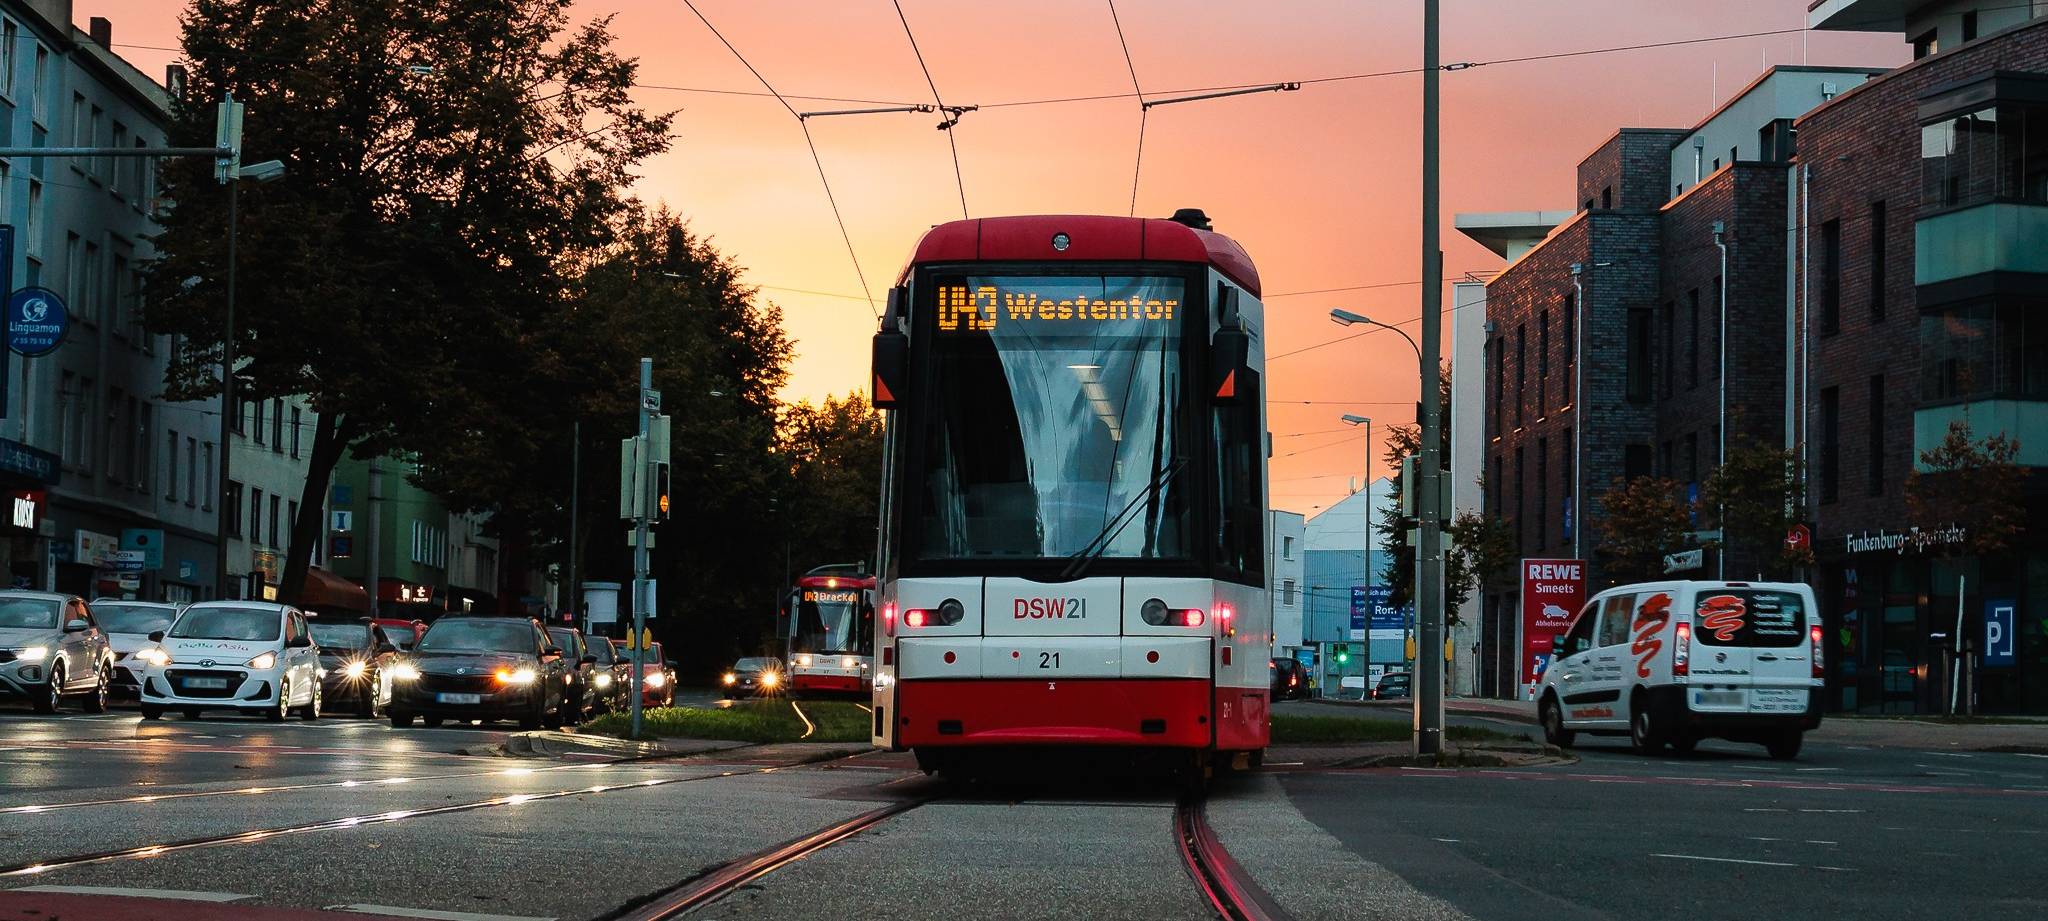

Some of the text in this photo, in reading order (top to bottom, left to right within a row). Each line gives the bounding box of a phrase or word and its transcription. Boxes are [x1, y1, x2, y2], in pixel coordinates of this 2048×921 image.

[938, 286, 1179, 331] U43 Westentor
[9, 321, 60, 334] Linguamon
[13, 497, 36, 528] KIOSK
[1528, 564, 1581, 580] REWE
[1535, 582, 1574, 594] Smeets
[804, 592, 819, 602] U43
[1535, 620, 1574, 628] Abholservice
[1987, 621, 2002, 656] P
[1038, 652, 1060, 669] 21
